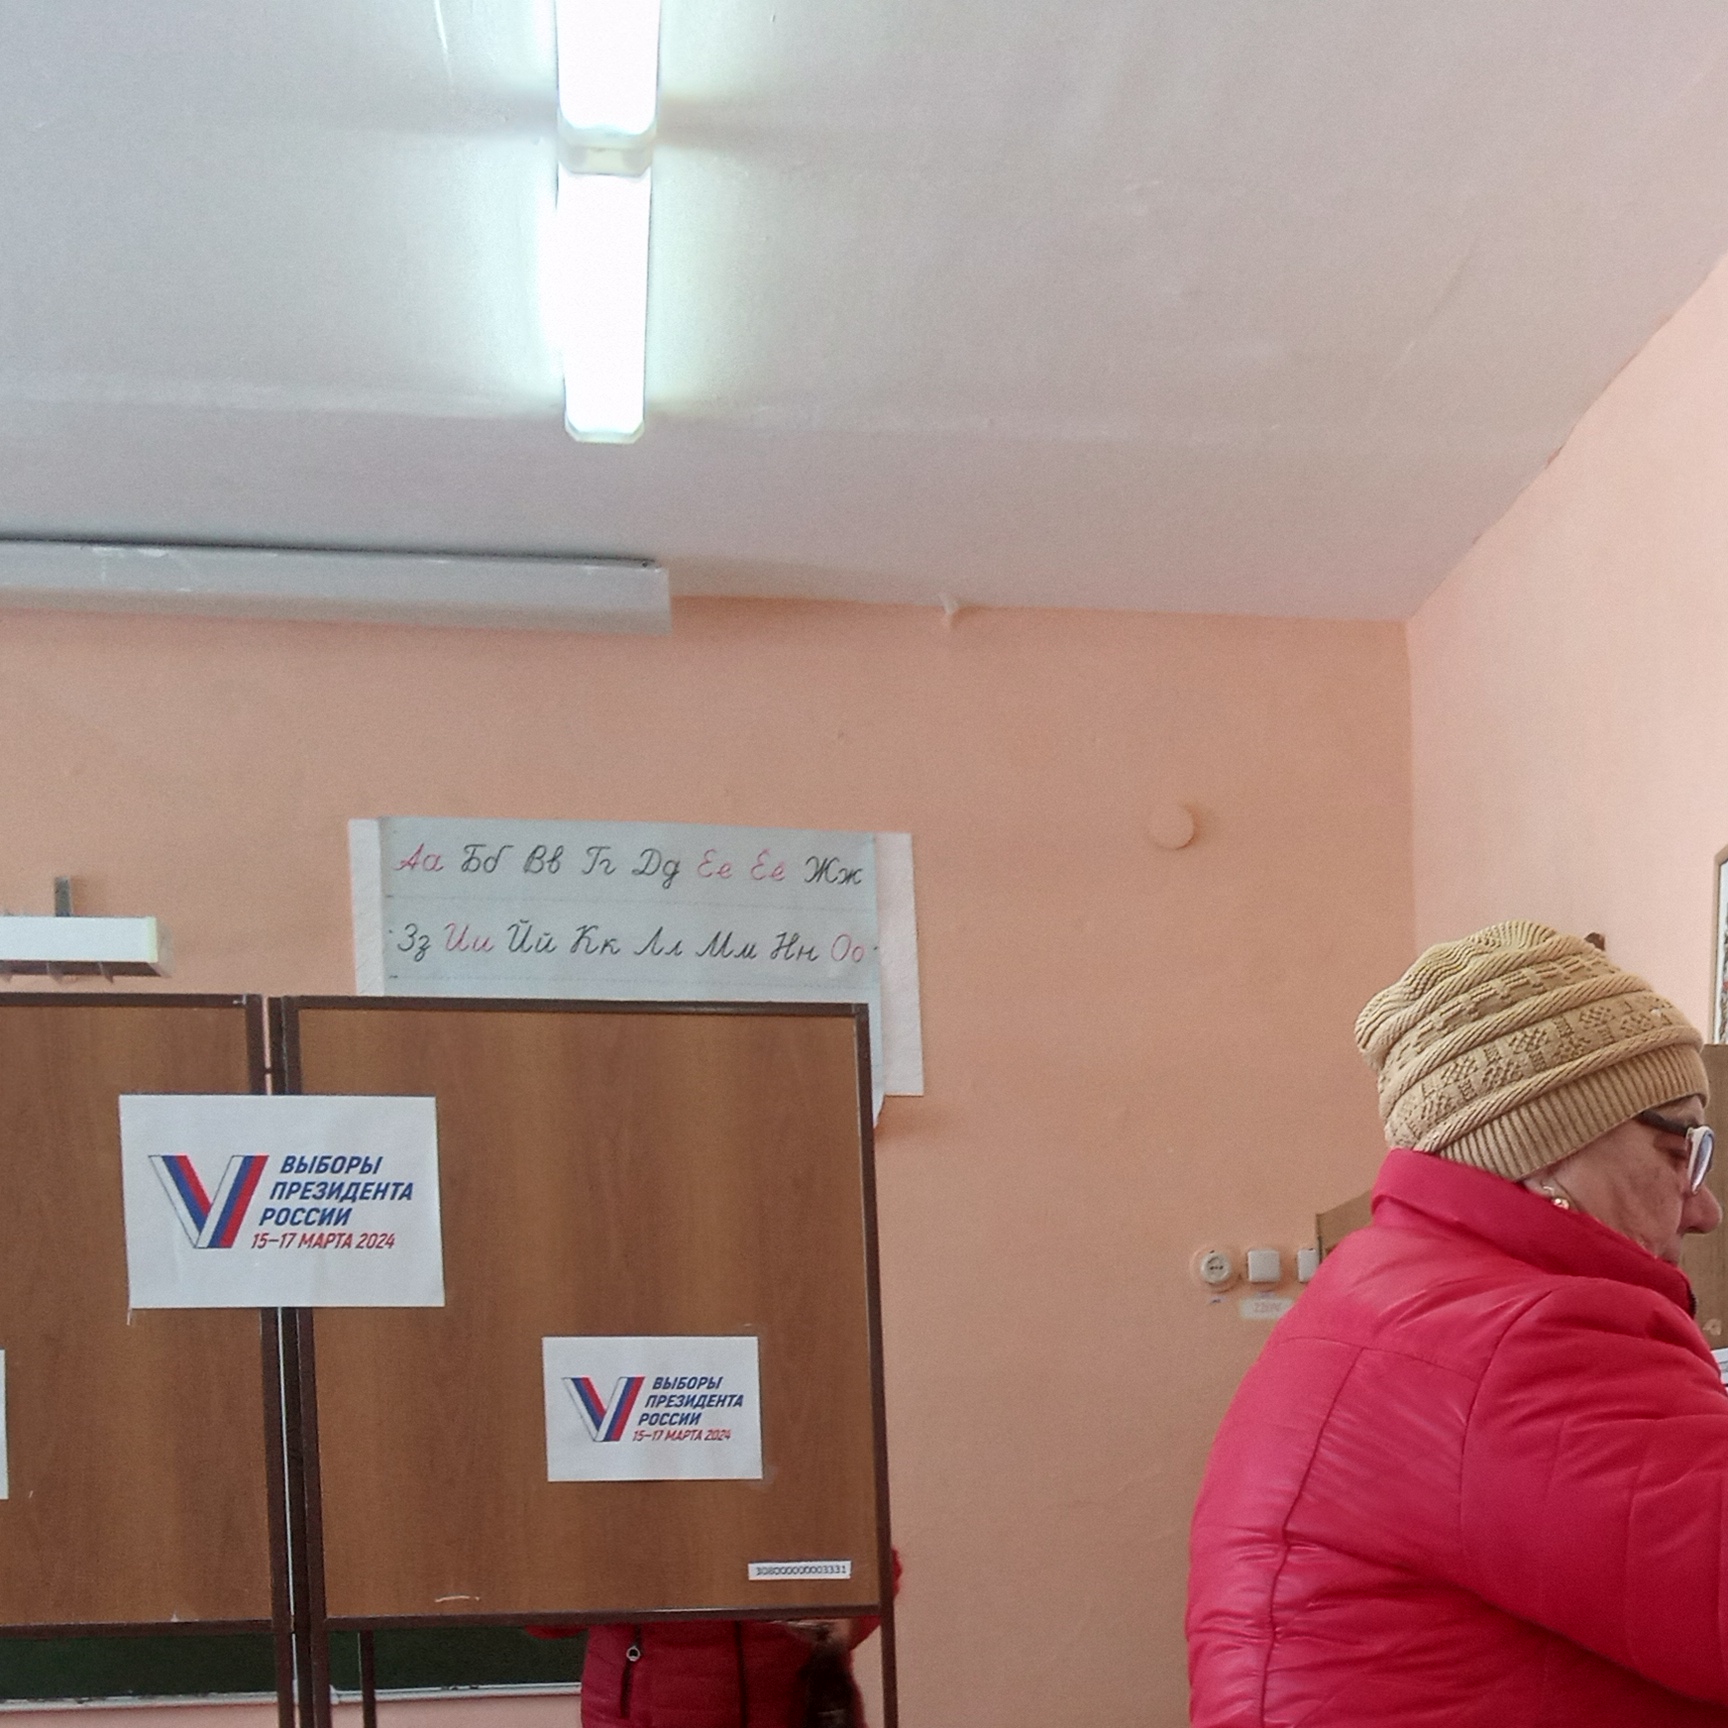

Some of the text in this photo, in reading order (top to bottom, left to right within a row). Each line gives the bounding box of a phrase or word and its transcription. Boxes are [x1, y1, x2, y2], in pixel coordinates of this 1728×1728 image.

[393, 843, 444, 872] Аа
[461, 844, 514, 873] Бб
[523, 845, 564, 874] Вв
[581, 846, 617, 875] Гг
[632, 848, 681, 889] Дд
[697, 849, 732, 878] Ее
[804, 856, 864, 885] Жж
[397, 919, 865, 963] Зз Ии Йй Кк Лл Мм Нн Оо
[280, 1155, 383, 1174] ВЫБОРЫ
[270, 1181, 414, 1202] ПРЕЗИДЕНТА
[259, 1207, 353, 1226] РОССИИ
[298, 1233, 353, 1249] МАРТА
[356, 1233, 396, 1249] 2024
[652, 1376, 723, 1390] ВЫБОРЫ
[645, 1394, 744, 1409] ПРЕЗИДЕНТА
[638, 1413, 702, 1426] РОССИИ
[665, 1429, 703, 1441] МАРТА
[704, 1429, 732, 1441] 2024
